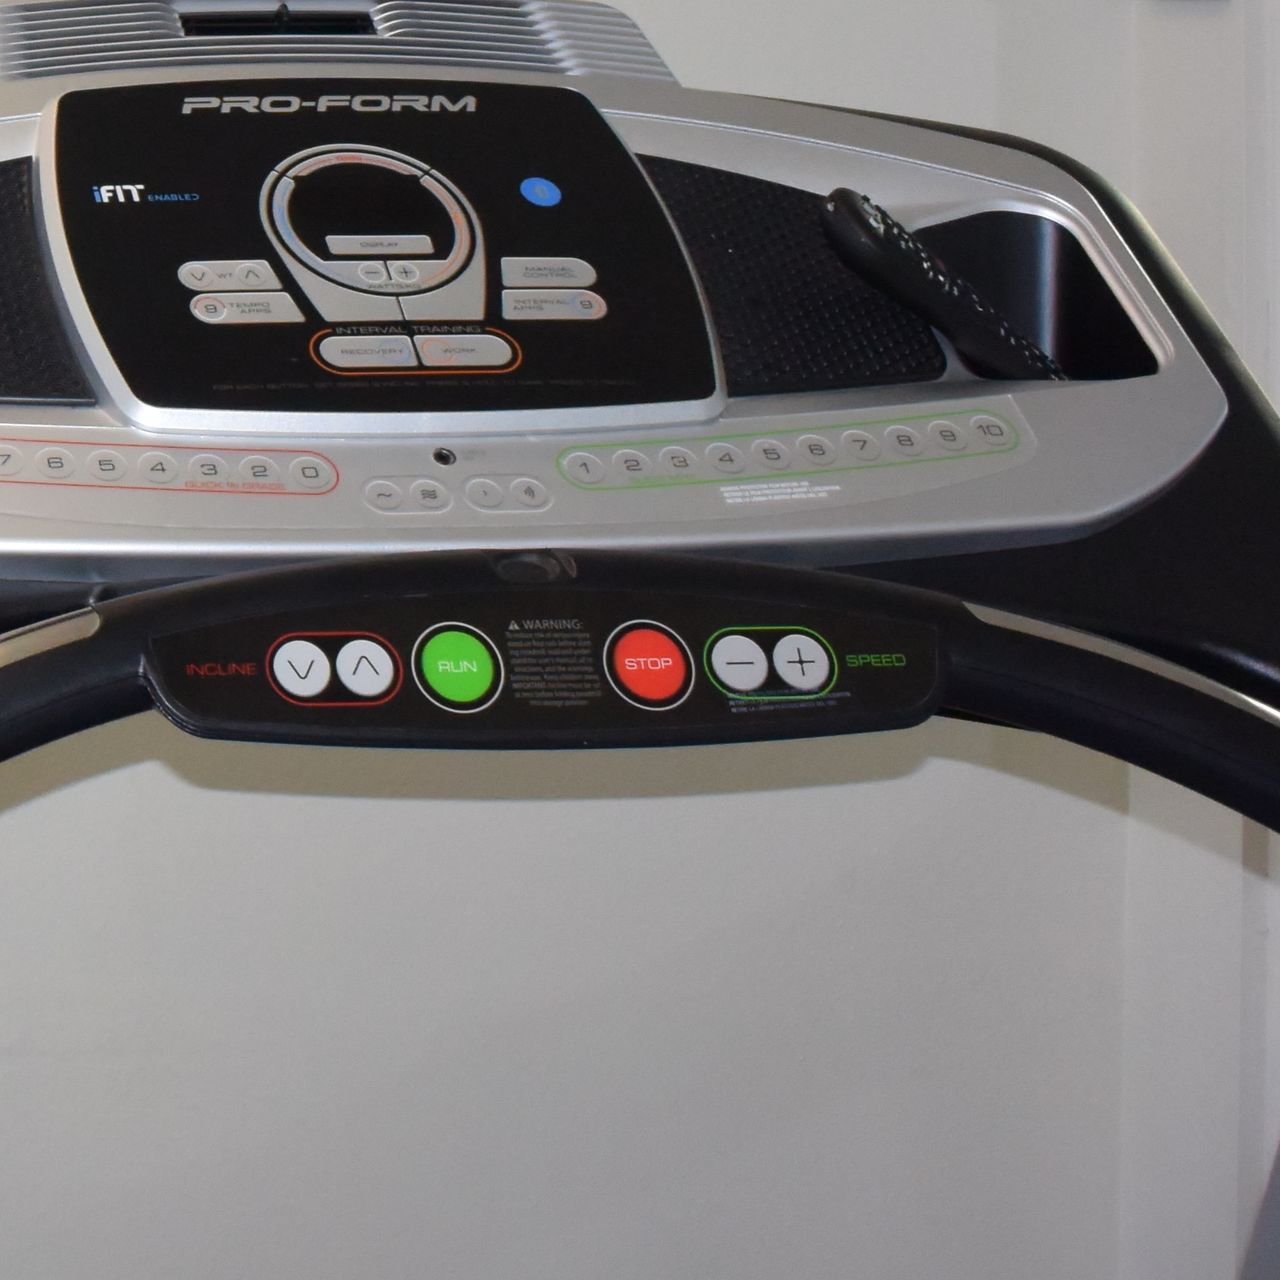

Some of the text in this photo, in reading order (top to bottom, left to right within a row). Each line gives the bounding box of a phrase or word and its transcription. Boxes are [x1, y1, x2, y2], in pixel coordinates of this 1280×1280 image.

[182, 95, 476, 114] PRO-FORM
[92, 185, 199, 202] iFIT ENABLED
[204, 304, 217, 313] 9
[336, 325, 481, 334] INTERVAL TRAINING
[579, 424, 1004, 473] 1 2 3 4 5 6 7 8 9 10
[47, 457, 64, 469] 6
[98, 460, 116, 471] 5
[150, 462, 167, 472] 4
[200, 464, 218, 476] 3
[251, 465, 269, 477] 2
[301, 466, 319, 479] 0
[521, 619, 583, 629] WARNING:
[625, 658, 672, 670] STOP
[845, 654, 906, 666] SPEED
[186, 663, 256, 676] INCLINE
[438, 661, 477, 673] RUN
